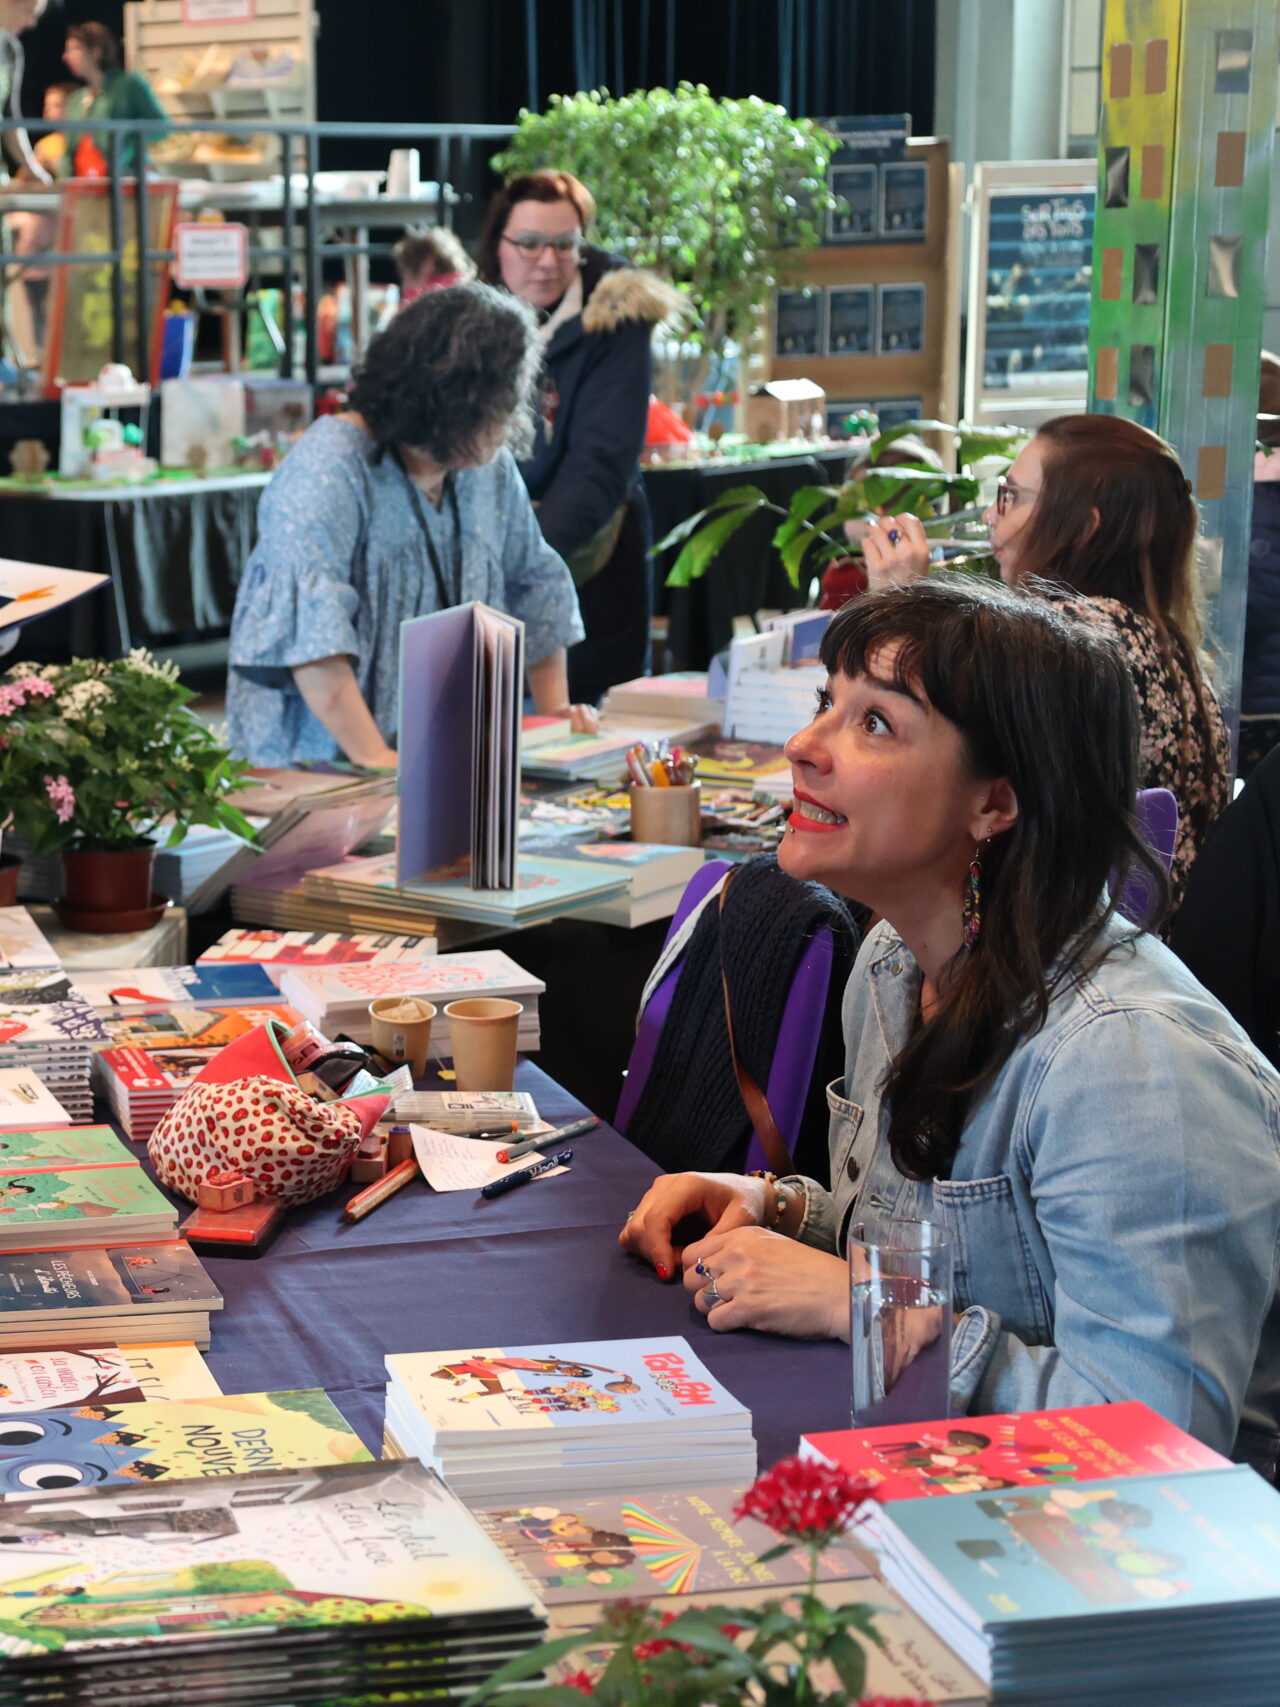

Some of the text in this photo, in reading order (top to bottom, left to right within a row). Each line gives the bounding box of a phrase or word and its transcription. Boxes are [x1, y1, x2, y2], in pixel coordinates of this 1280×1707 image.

[50, 1260, 82, 1299] LES PÊCHEURS
[30, 1365, 46, 1375] en
[181, 1425, 237, 1477] NOUVE
[373, 1499, 449, 1562] Le soleil
[342, 1536, 397, 1566] face
